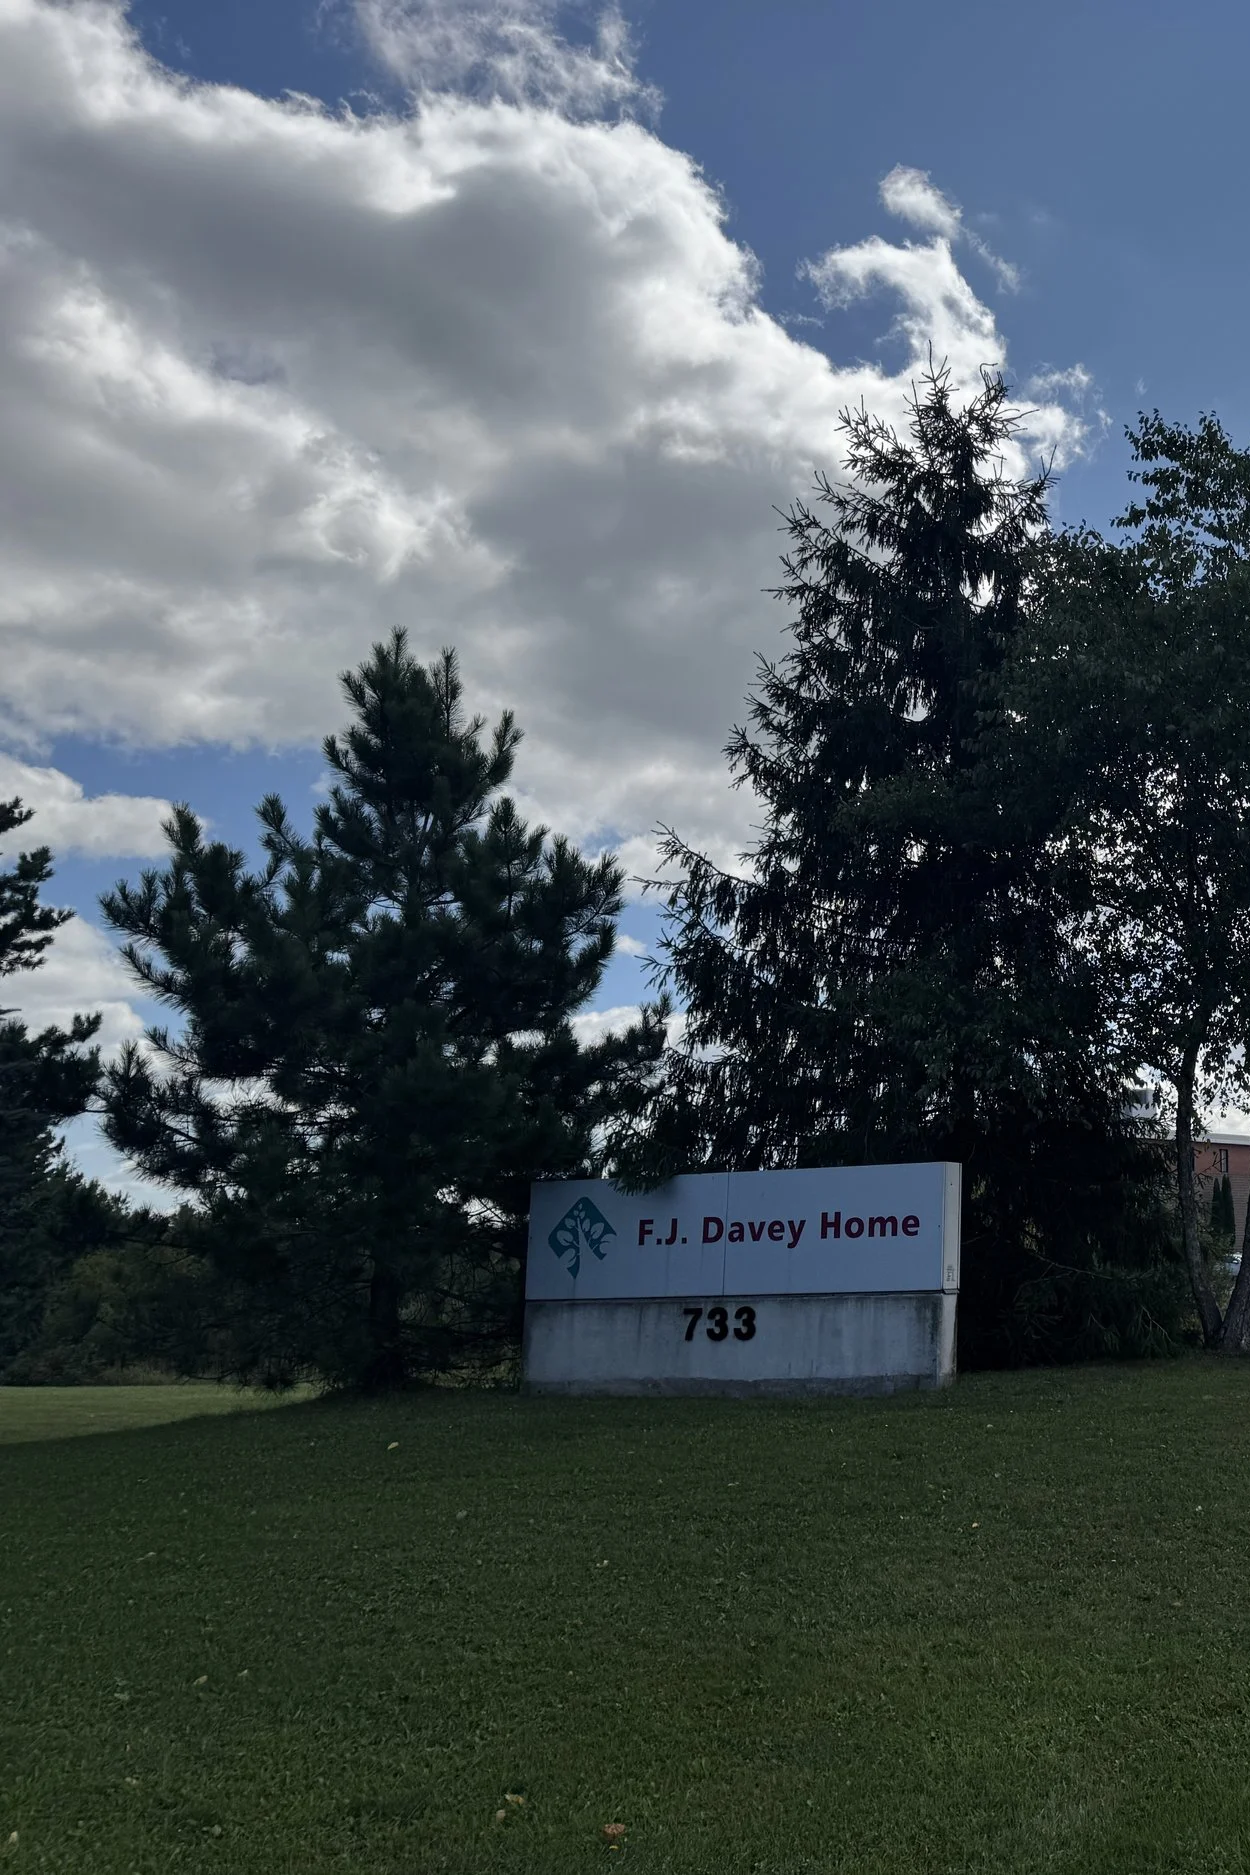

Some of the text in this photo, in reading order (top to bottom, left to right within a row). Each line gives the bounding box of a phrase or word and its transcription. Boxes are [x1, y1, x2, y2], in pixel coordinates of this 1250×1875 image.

[638, 1211, 920, 1249] F.J. Davey Home
[683, 1305, 757, 1342] 733
